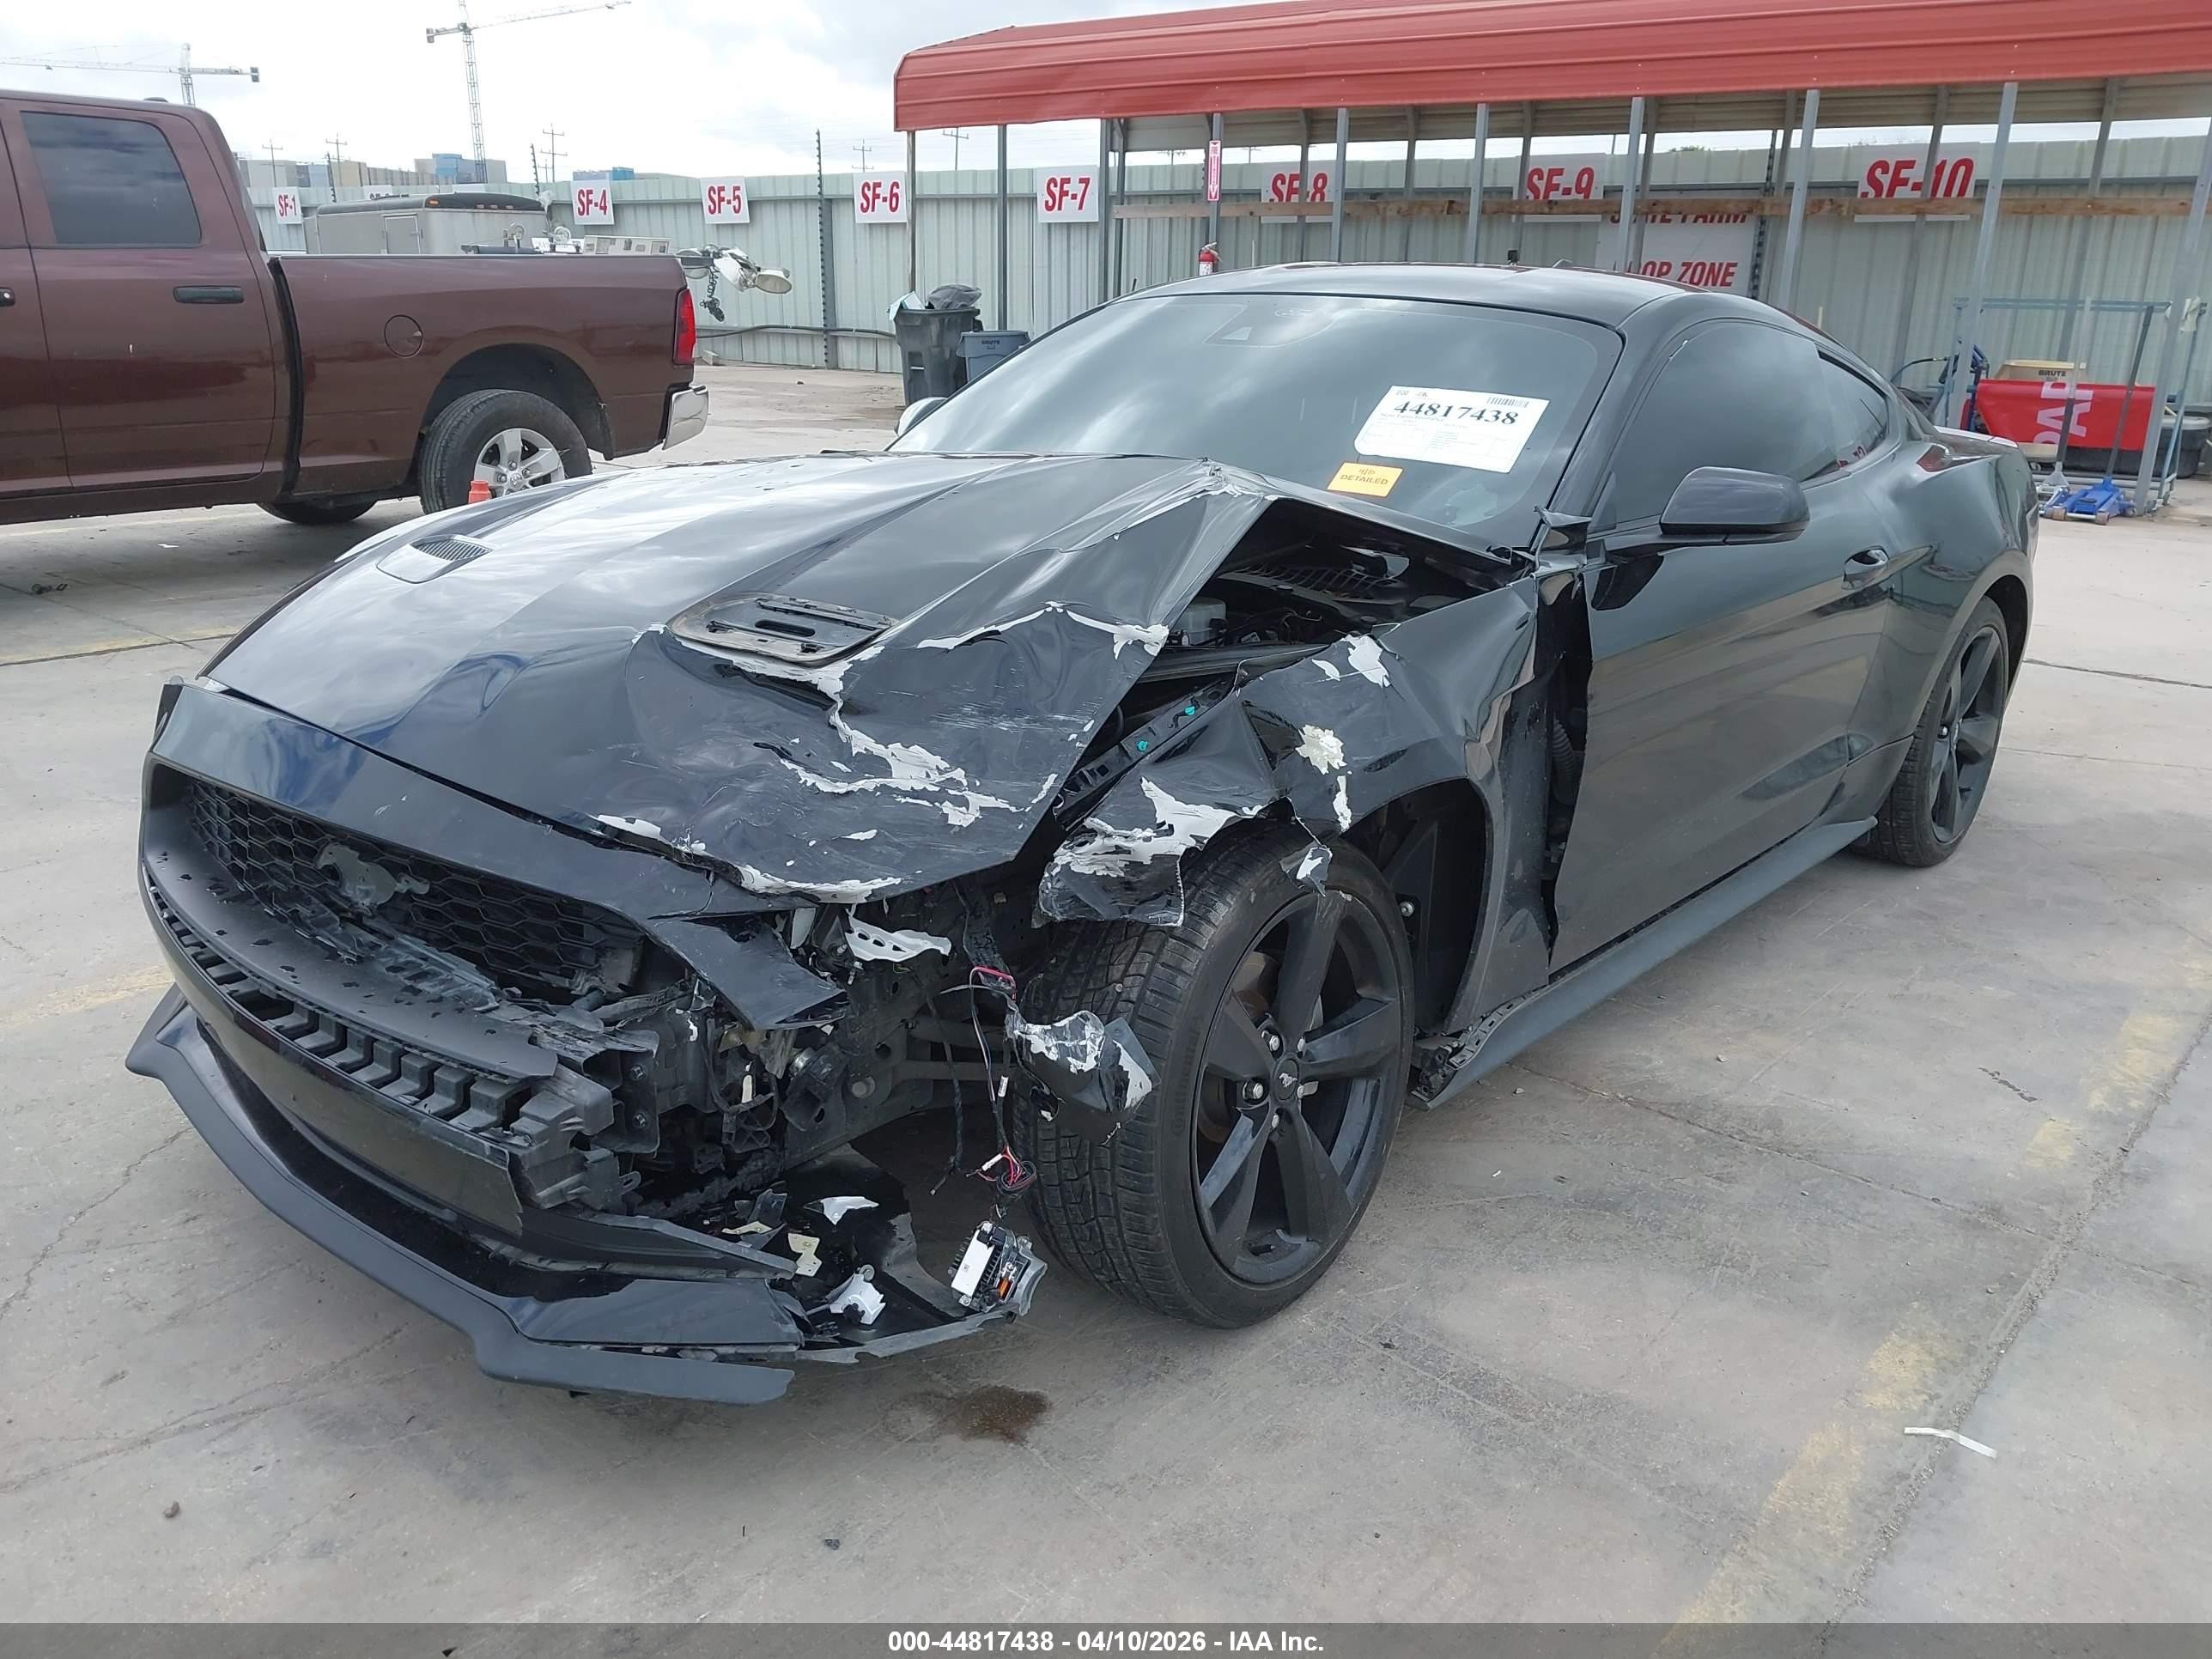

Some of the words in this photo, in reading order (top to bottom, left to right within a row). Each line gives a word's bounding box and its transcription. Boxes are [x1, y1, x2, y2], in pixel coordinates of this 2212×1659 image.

[1527, 167, 1595, 200] SF-9
[1860, 157, 1974, 199] SF-10
[278, 194, 297, 217] SF-1
[577, 189, 608, 216] SF-4
[707, 185, 742, 215] SF-5
[860, 181, 900, 213] SF-6
[1044, 177, 1091, 212] SF-7
[1677, 261, 1739, 287] ZONE
[1395, 400, 1518, 425] 44817438
[1340, 474, 1389, 485] DETAILED
